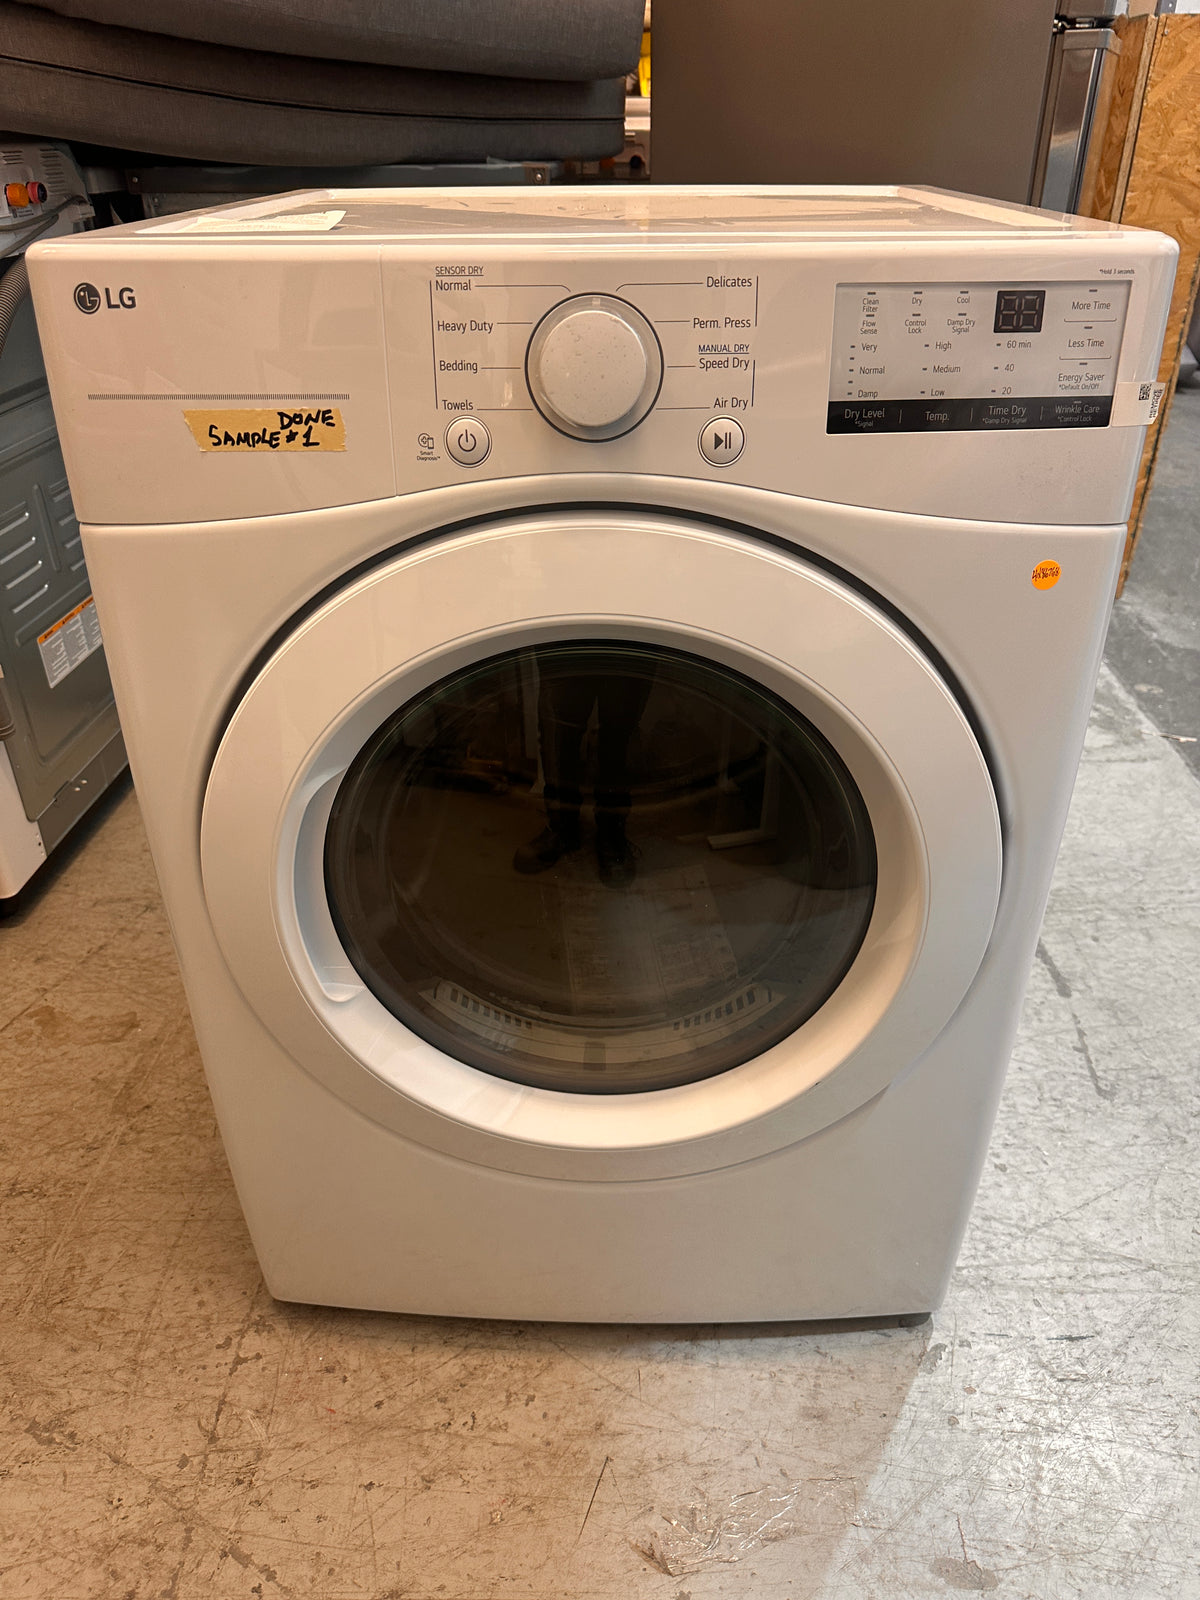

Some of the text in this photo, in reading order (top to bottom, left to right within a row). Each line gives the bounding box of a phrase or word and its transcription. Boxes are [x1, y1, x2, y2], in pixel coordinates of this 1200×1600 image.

[435, 265, 484, 275] SENSOR DRY
[435, 279, 472, 291] Normal
[706, 275, 753, 288] Delicates
[104, 286, 137, 309] LG
[862, 298, 880, 306] Clean
[911, 297, 922, 306] Dry
[956, 296, 971, 304] Cool
[862, 305, 878, 313] Filter
[1071, 300, 1111, 310] More Time
[437, 319, 494, 334] Heavy Duty
[693, 316, 752, 329] Perm. Press
[904, 319, 927, 327] Control
[946, 318, 976, 327] Damp Dry
[952, 326, 970, 335] Signal
[698, 343, 750, 353] MANUAL DRY
[861, 342, 878, 353] Very
[935, 341, 952, 352] High
[1006, 339, 1032, 349] 60 min
[1068, 338, 1105, 348] Less Time
[439, 359, 478, 375] Bedding
[699, 356, 750, 372] Speed Dry
[932, 364, 961, 374] Medium
[1004, 363, 1015, 372] 40
[859, 366, 886, 375] Normal
[1057, 372, 1105, 384] Energy Saver
[857, 389, 879, 399] Damp
[930, 388, 945, 397] Low
[1001, 386, 1012, 395] 20
[442, 399, 474, 411] Towels
[713, 396, 749, 411] Air Dry
[1055, 404, 1100, 413] Wrinkle Care
[844, 407, 886, 420] Dry Level
[988, 405, 1027, 416] Time Dry
[277, 408, 336, 430] DONE
[925, 411, 950, 423] Temp.
[208, 424, 282, 449] SAMPLE
